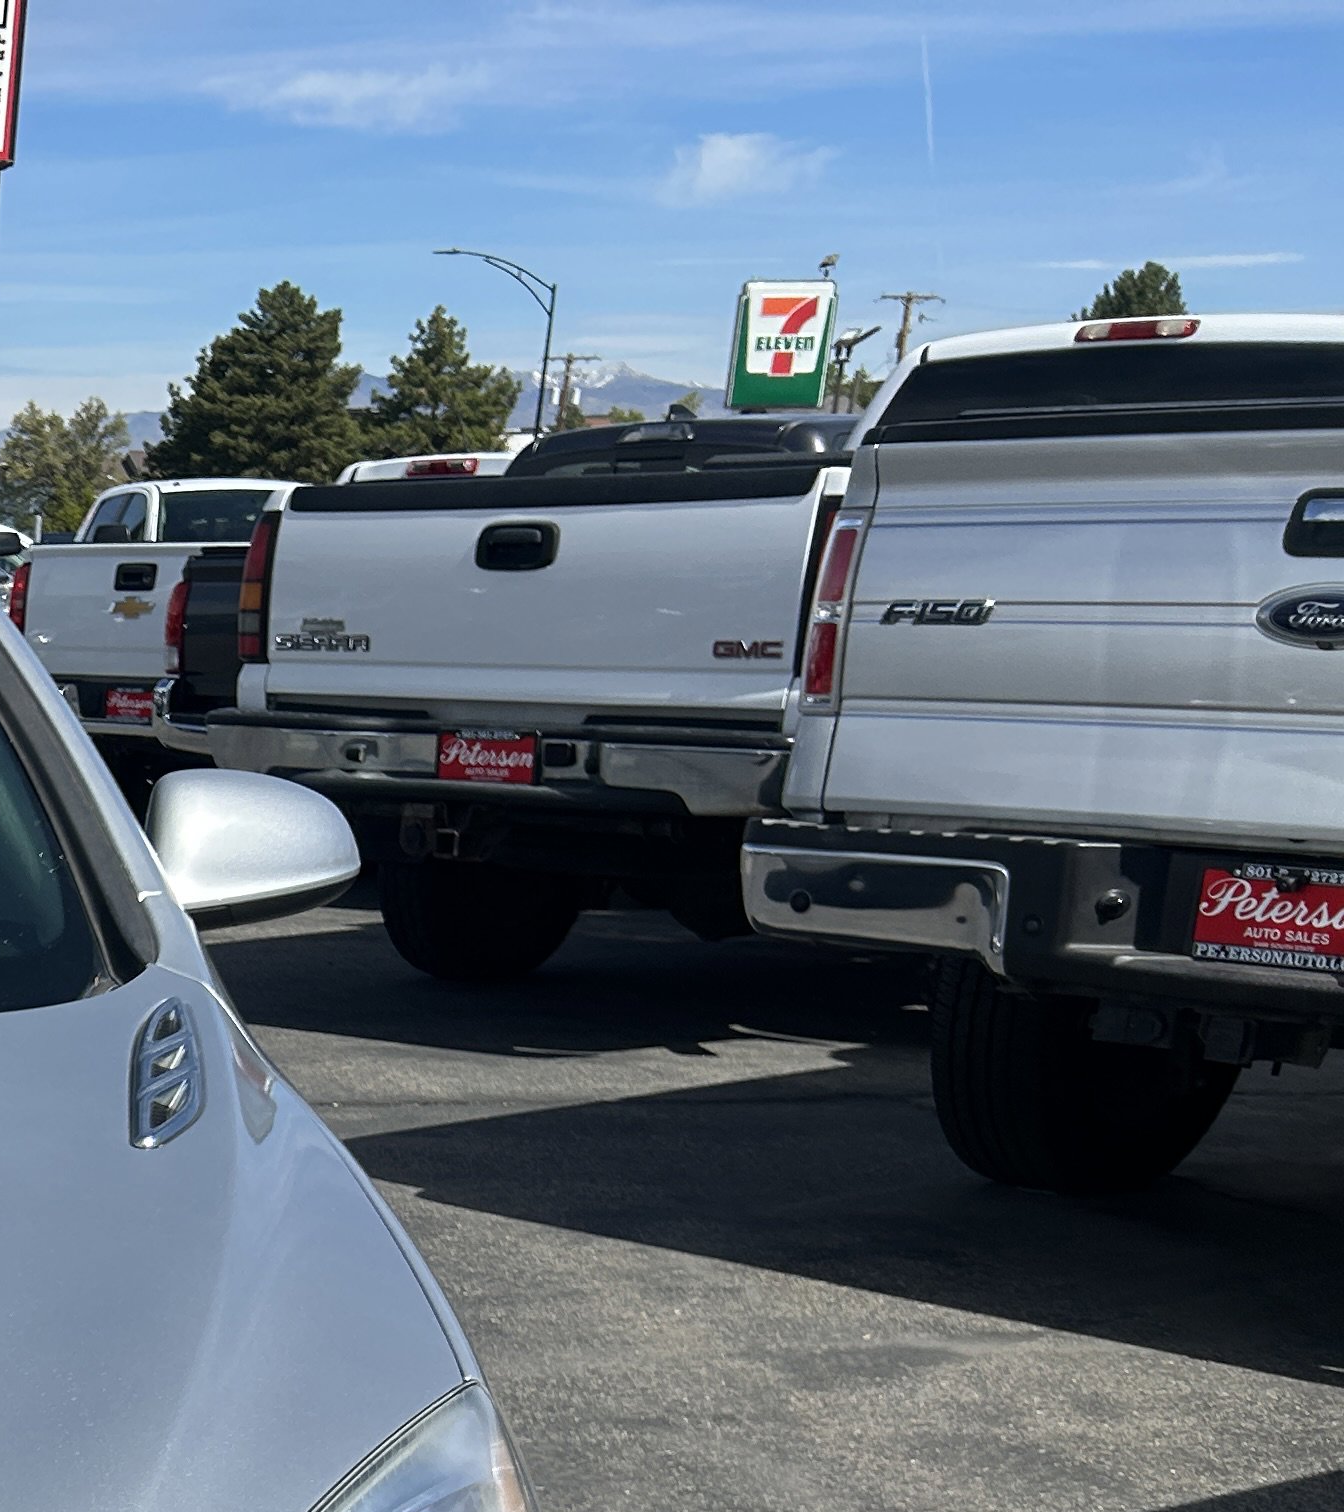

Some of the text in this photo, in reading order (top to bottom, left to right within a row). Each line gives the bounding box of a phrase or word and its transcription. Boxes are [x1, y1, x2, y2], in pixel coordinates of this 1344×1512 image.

[760, 296, 820, 375] 7
[712, 640, 784, 659] GMC
[439, 738, 534, 769] Peterson
[1243, 927, 1331, 945] AUTO SALES
